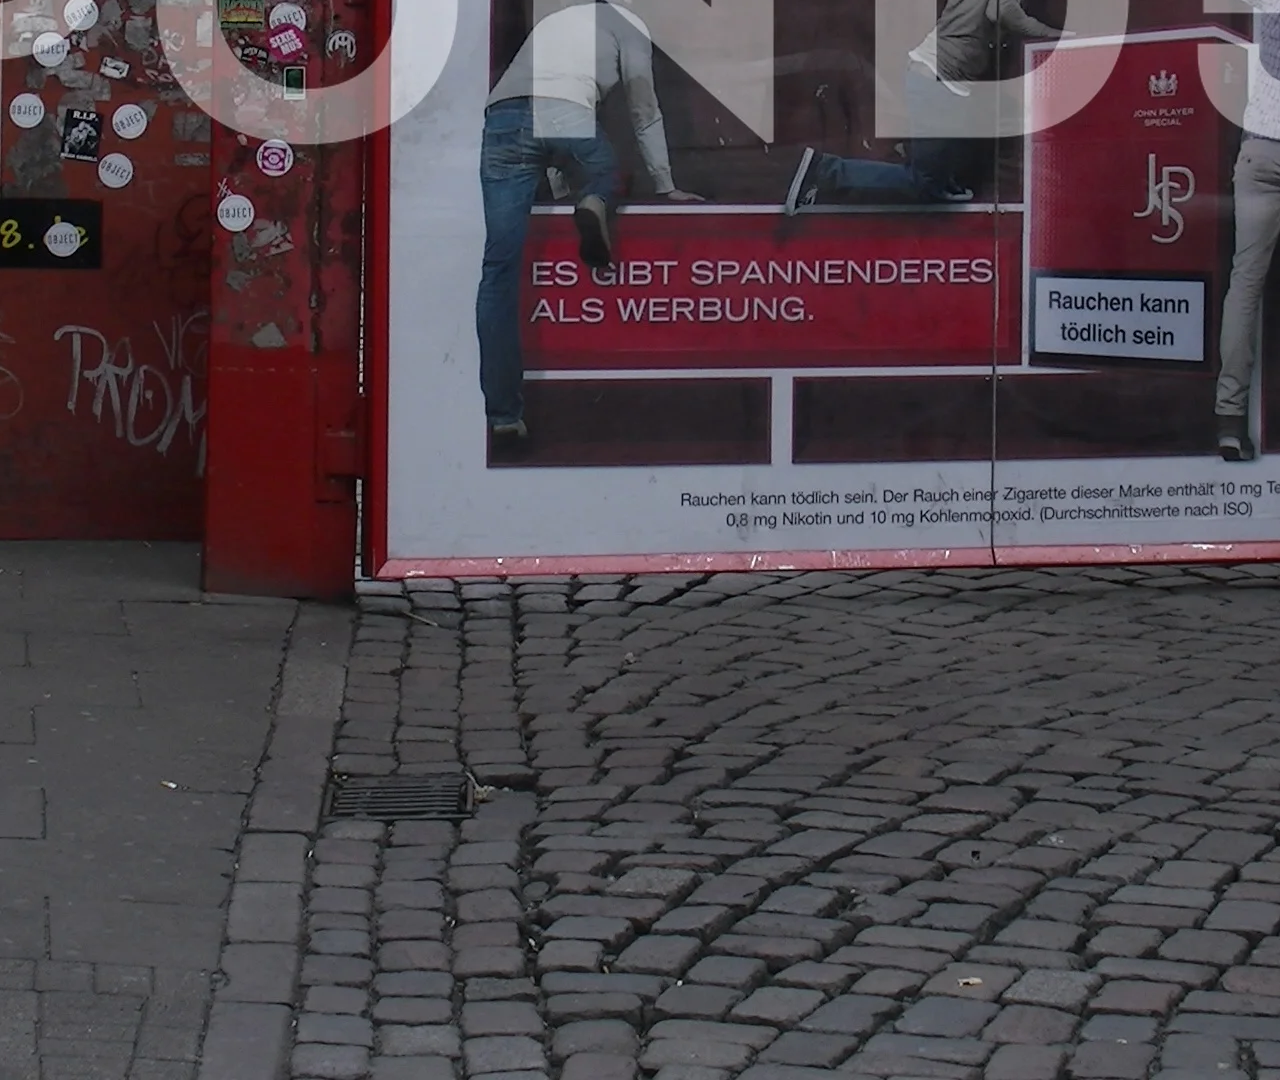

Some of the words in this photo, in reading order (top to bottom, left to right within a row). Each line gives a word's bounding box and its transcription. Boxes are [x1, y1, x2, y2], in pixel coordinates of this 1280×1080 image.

[67, 4, 96, 23] OBJECT
[35, 43, 65, 56] OBJECT
[11, 104, 43, 117] OBJECT
[72, 110, 100, 122] R.I.P.
[1133, 108, 1158, 118] JOHN
[1158, 107, 1194, 117] PLAYER
[115, 111, 145, 131] OBJECT
[1144, 118, 1182, 126] SPECIAL
[99, 161, 131, 180] OBJECT
[219, 206, 253, 219] OBJECT
[48, 233, 79, 246] OBJECT
[531, 262, 579, 286] ES
[591, 260, 678, 286] GIBT
[690, 258, 994, 285] SPANNENDERES
[530, 298, 605, 323] ALS
[617, 296, 815, 322] WERBUNG.
[1048, 291, 1133, 312] Rauchen
[1140, 293, 1189, 314] kann
[1060, 322, 1126, 343] tödlich
[1132, 326, 1174, 346] sein
[680, 492, 746, 507] Rauchen
[750, 492, 787, 506] kann
[791, 491, 839, 505] tödlich
[844, 490, 878, 504] sein.
[883, 489, 908, 503] Der
[913, 489, 960, 503] Rauch
[962, 488, 998, 502] einer
[1002, 487, 1067, 504] Zigarette
[1070, 486, 1116, 500] dieser
[1119, 484, 1163, 498] Marke
[1166, 483, 1214, 497] enthält
[1219, 482, 1235, 496] 10
[1239, 484, 1262, 498] mg
[725, 513, 749, 527] 0,8
[753, 515, 777, 529] mg
[782, 512, 832, 526] Nikotin
[836, 511, 864, 525] und
[870, 511, 886, 525] 10
[891, 512, 915, 527] mg
[919, 507, 1035, 525] Kohlenmonoxid.
[1039, 504, 1180, 522] (Durchschnittswerte
[1184, 502, 1219, 517] nach
[1223, 501, 1254, 518] ISO)
